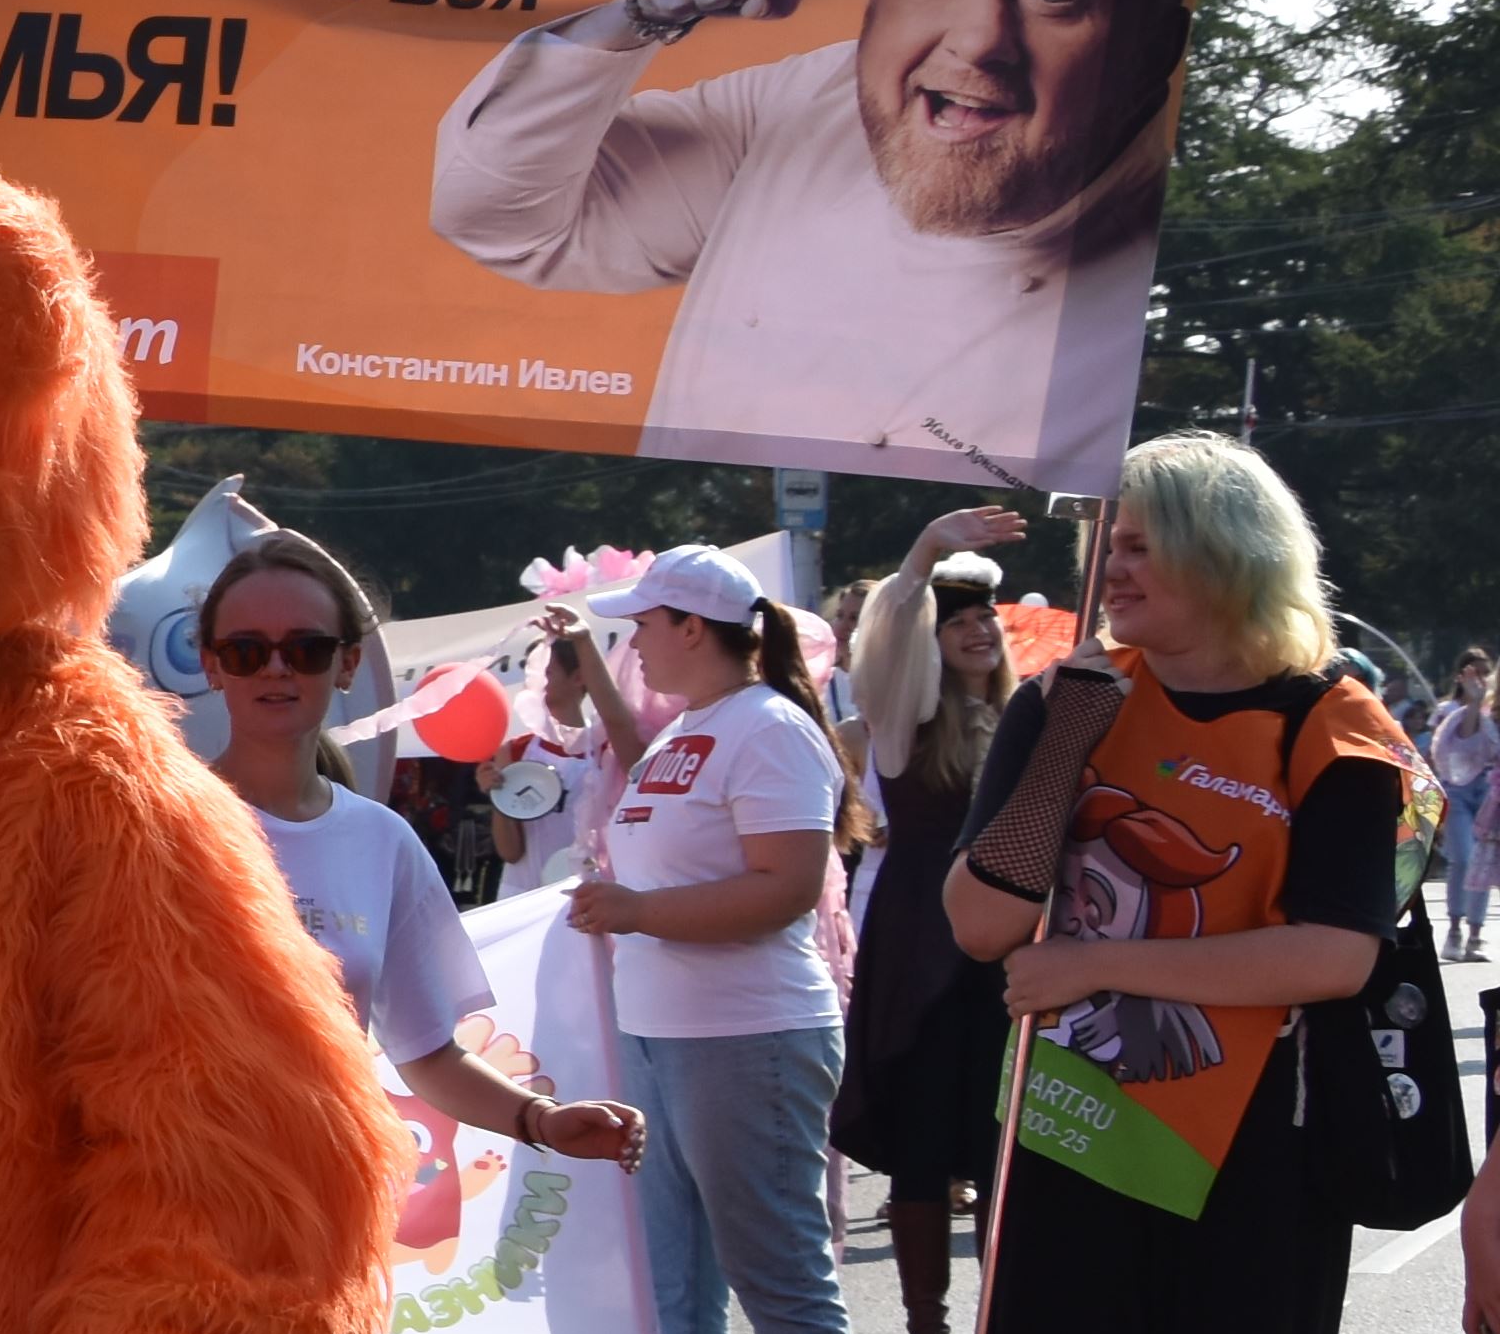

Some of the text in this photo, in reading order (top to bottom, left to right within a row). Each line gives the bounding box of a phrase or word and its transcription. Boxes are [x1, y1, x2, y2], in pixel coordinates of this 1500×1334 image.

[296, 343, 633, 396] Константин Ивлев
[630, 743, 702, 786] Tube
[1026, 1069, 1116, 1130] ART.RU
